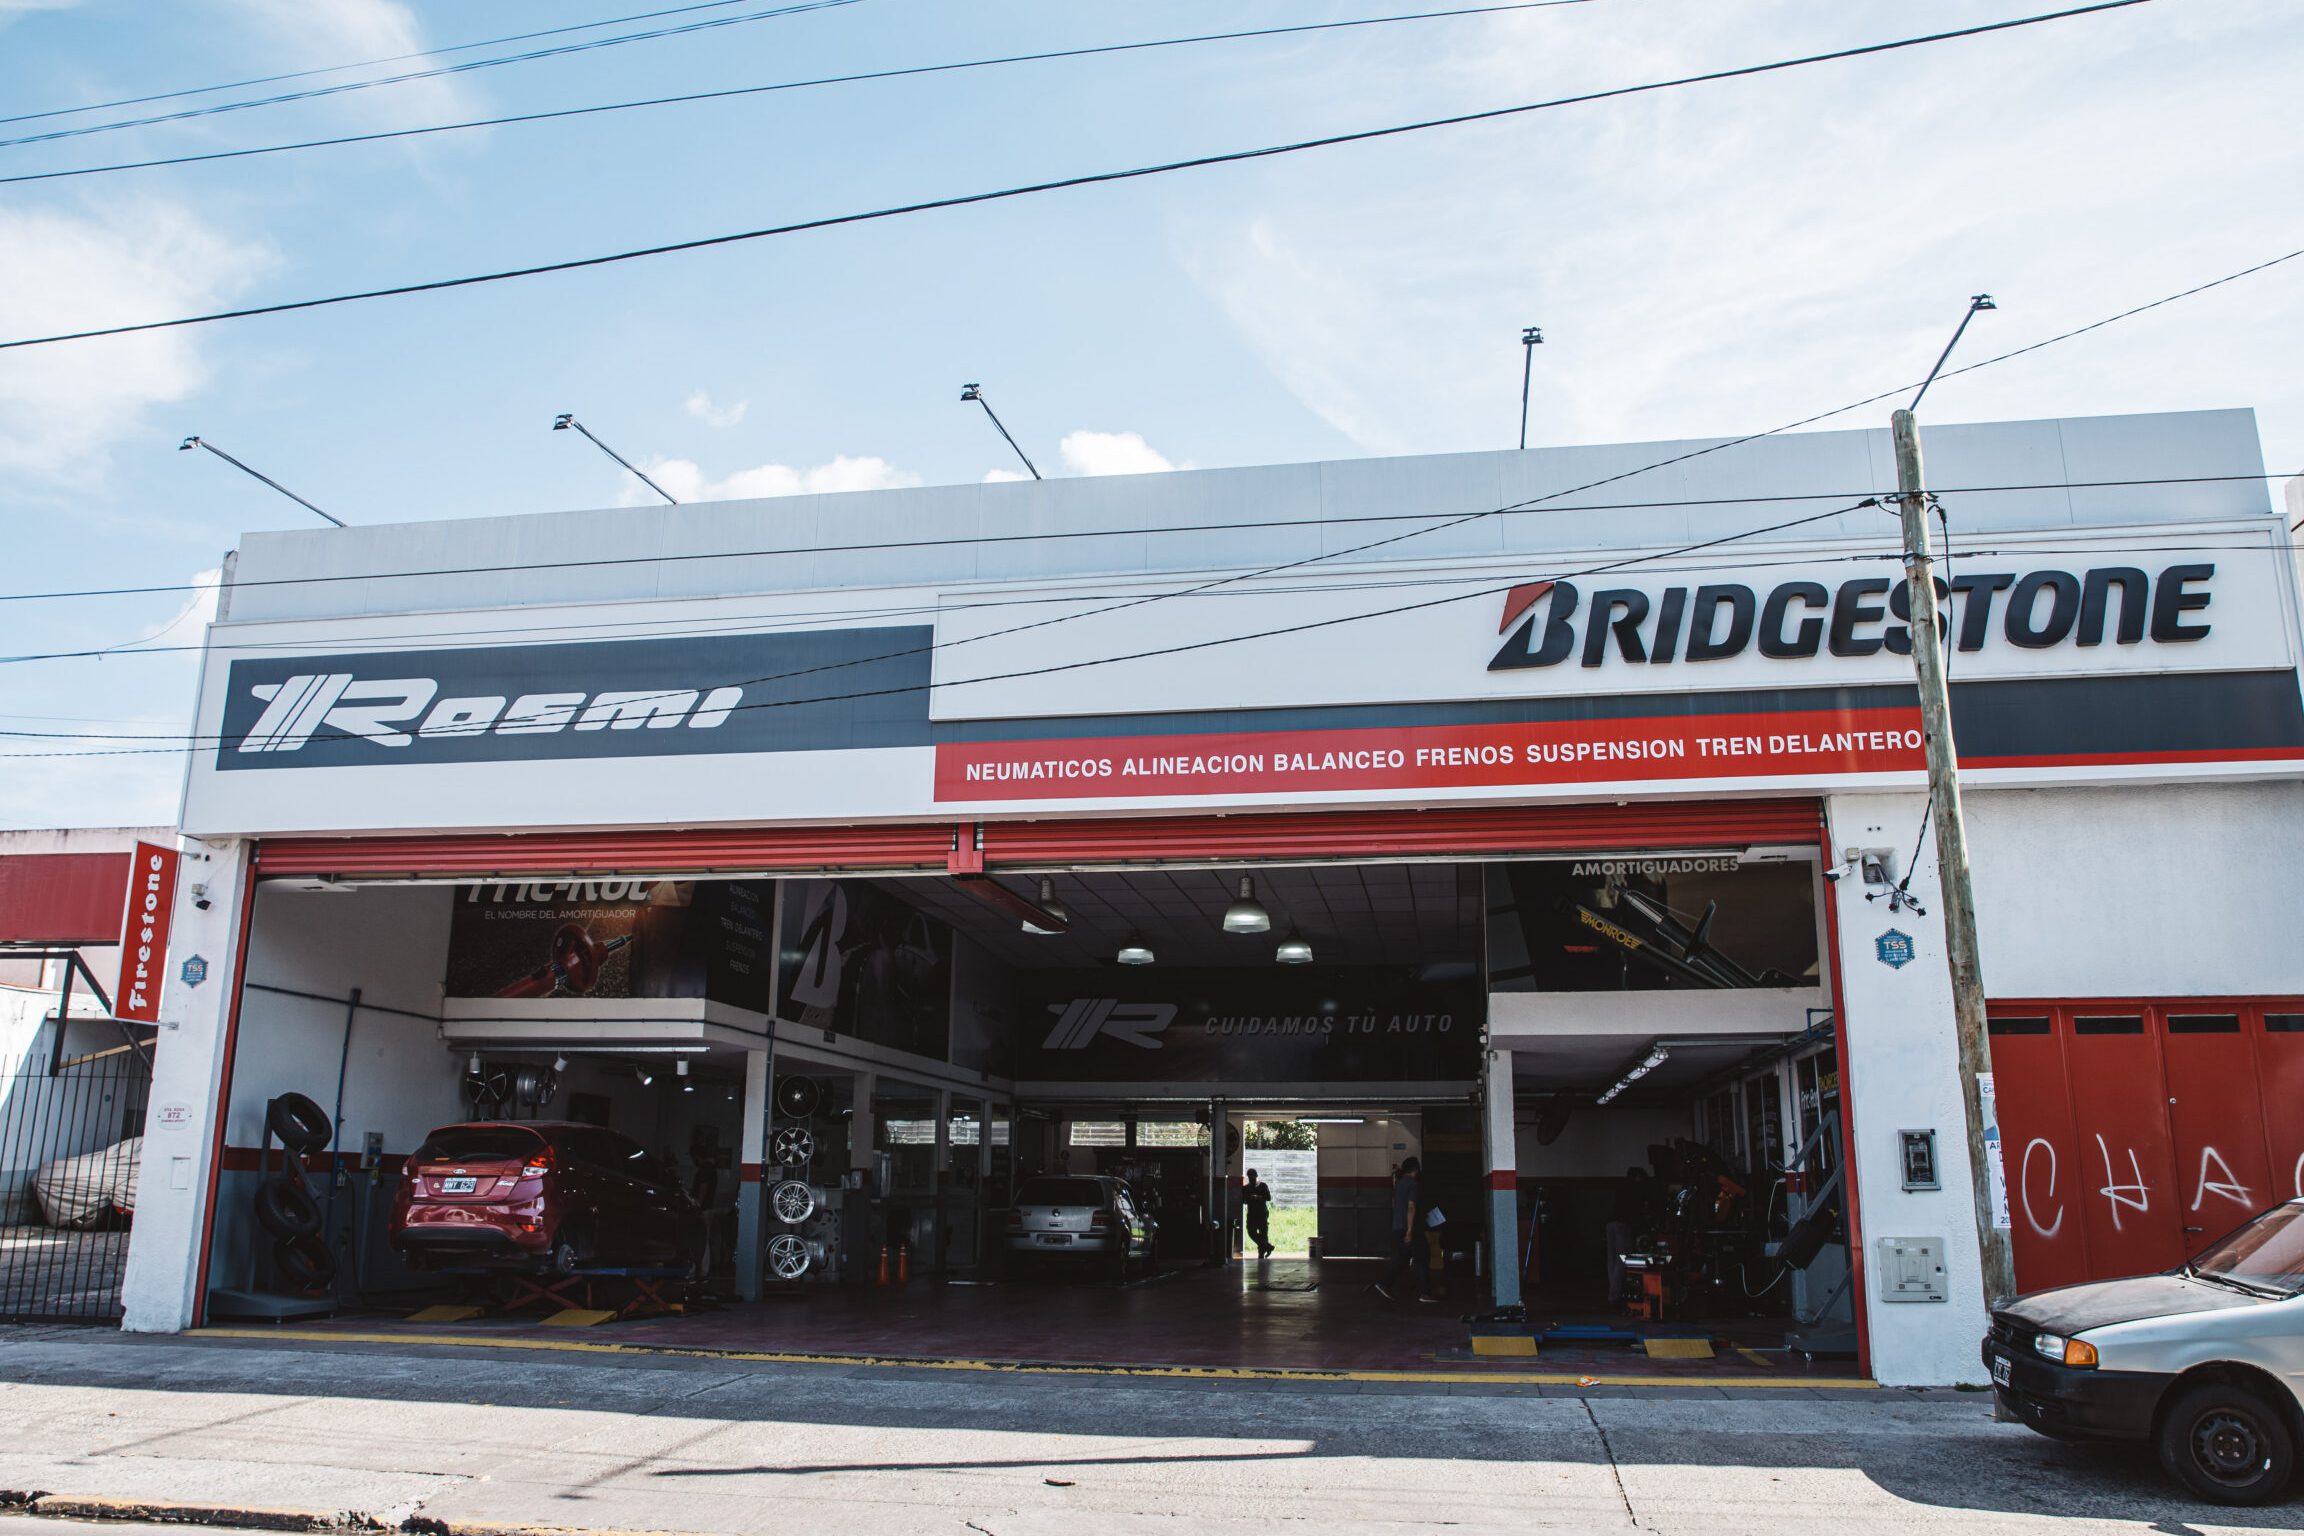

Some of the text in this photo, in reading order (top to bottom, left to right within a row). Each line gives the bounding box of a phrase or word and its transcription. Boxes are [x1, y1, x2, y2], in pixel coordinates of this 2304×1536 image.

[966, 729, 1922, 781] NEUMATICOS ALINEACION BALANCEO FRENOS SUSPENSION TREN DELANTERO
[1571, 858, 1740, 876] AMORTIGUADORES
[485, 909, 636, 920] EL NOMBRE DEL AMORTIGUADOR
[128, 854, 163, 1011] Firestone
[1583, 913, 1636, 948] MONROE
[1883, 940, 1908, 951] TSS
[1203, 1015, 1335, 1036] CUIDAMOS
[1386, 1013, 1454, 1034] AUTO
